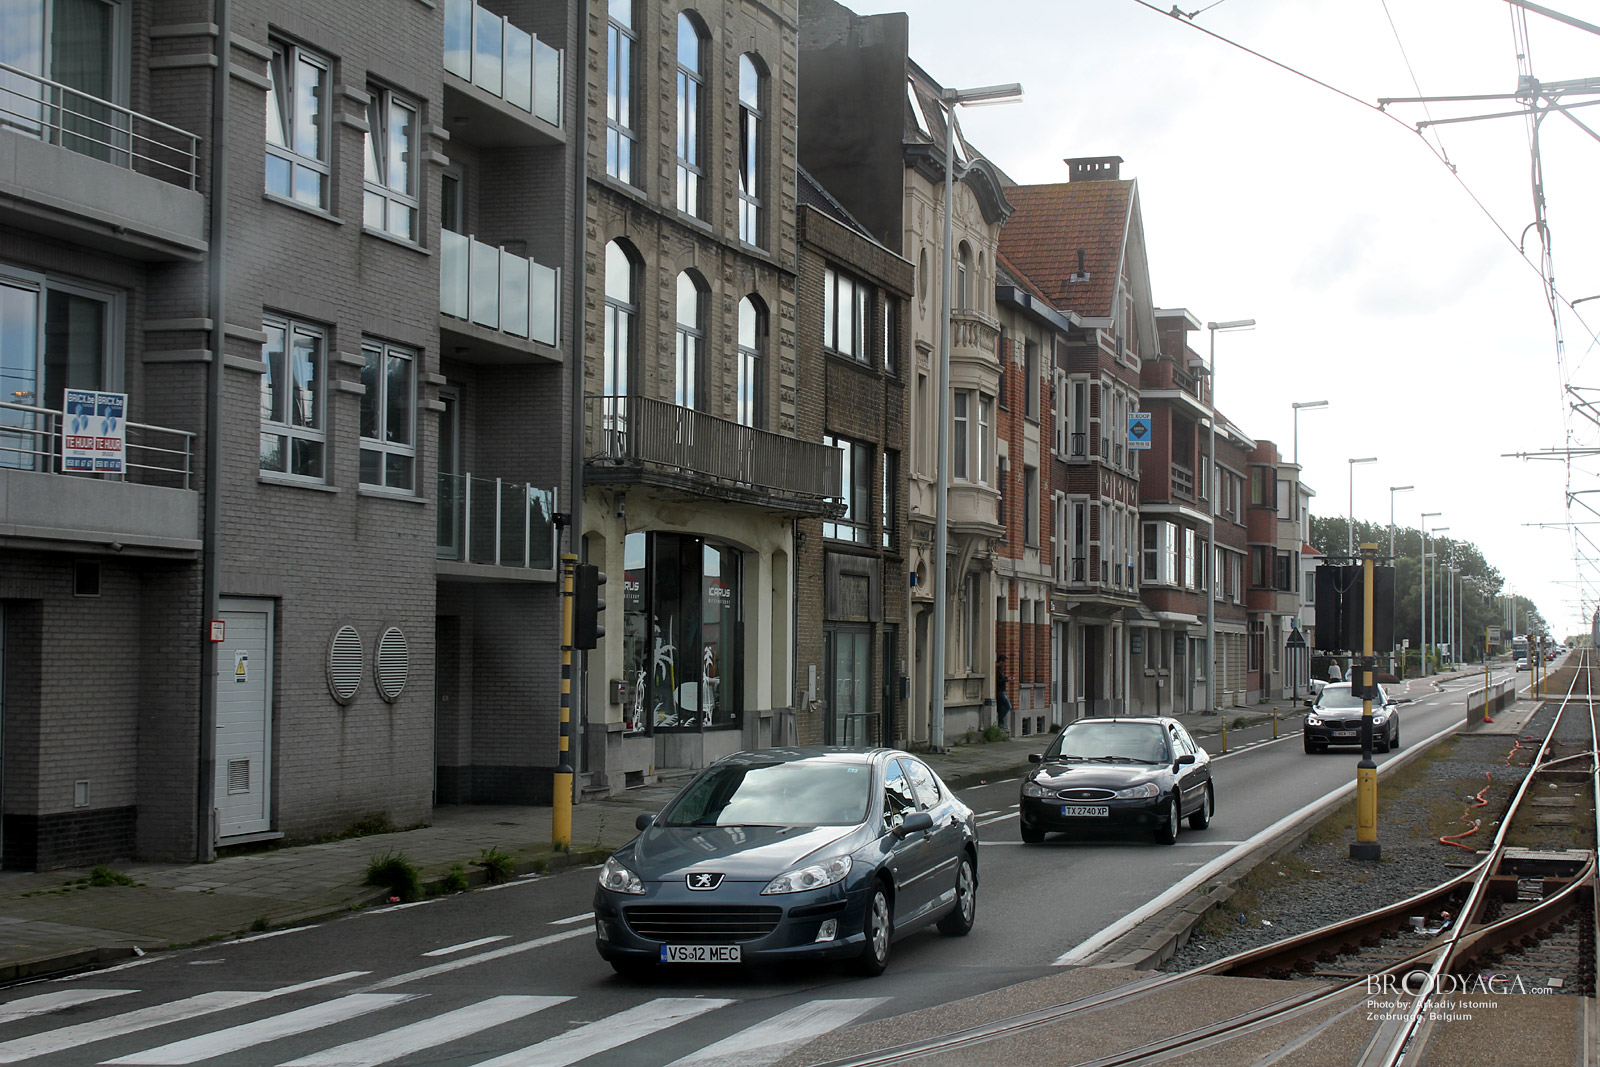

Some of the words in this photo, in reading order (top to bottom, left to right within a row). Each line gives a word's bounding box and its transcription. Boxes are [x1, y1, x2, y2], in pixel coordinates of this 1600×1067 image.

[66, 436, 75, 448] TE
[75, 437, 94, 449] HUUR
[96, 438, 105, 450] TE
[106, 439, 121, 450] HUUR
[624, 581, 640, 591] RUS
[708, 587, 730, 597] ICARUS
[668, 946, 688, 960] VS
[692, 946, 706, 960] 12
[710, 946, 739, 960] MEC
